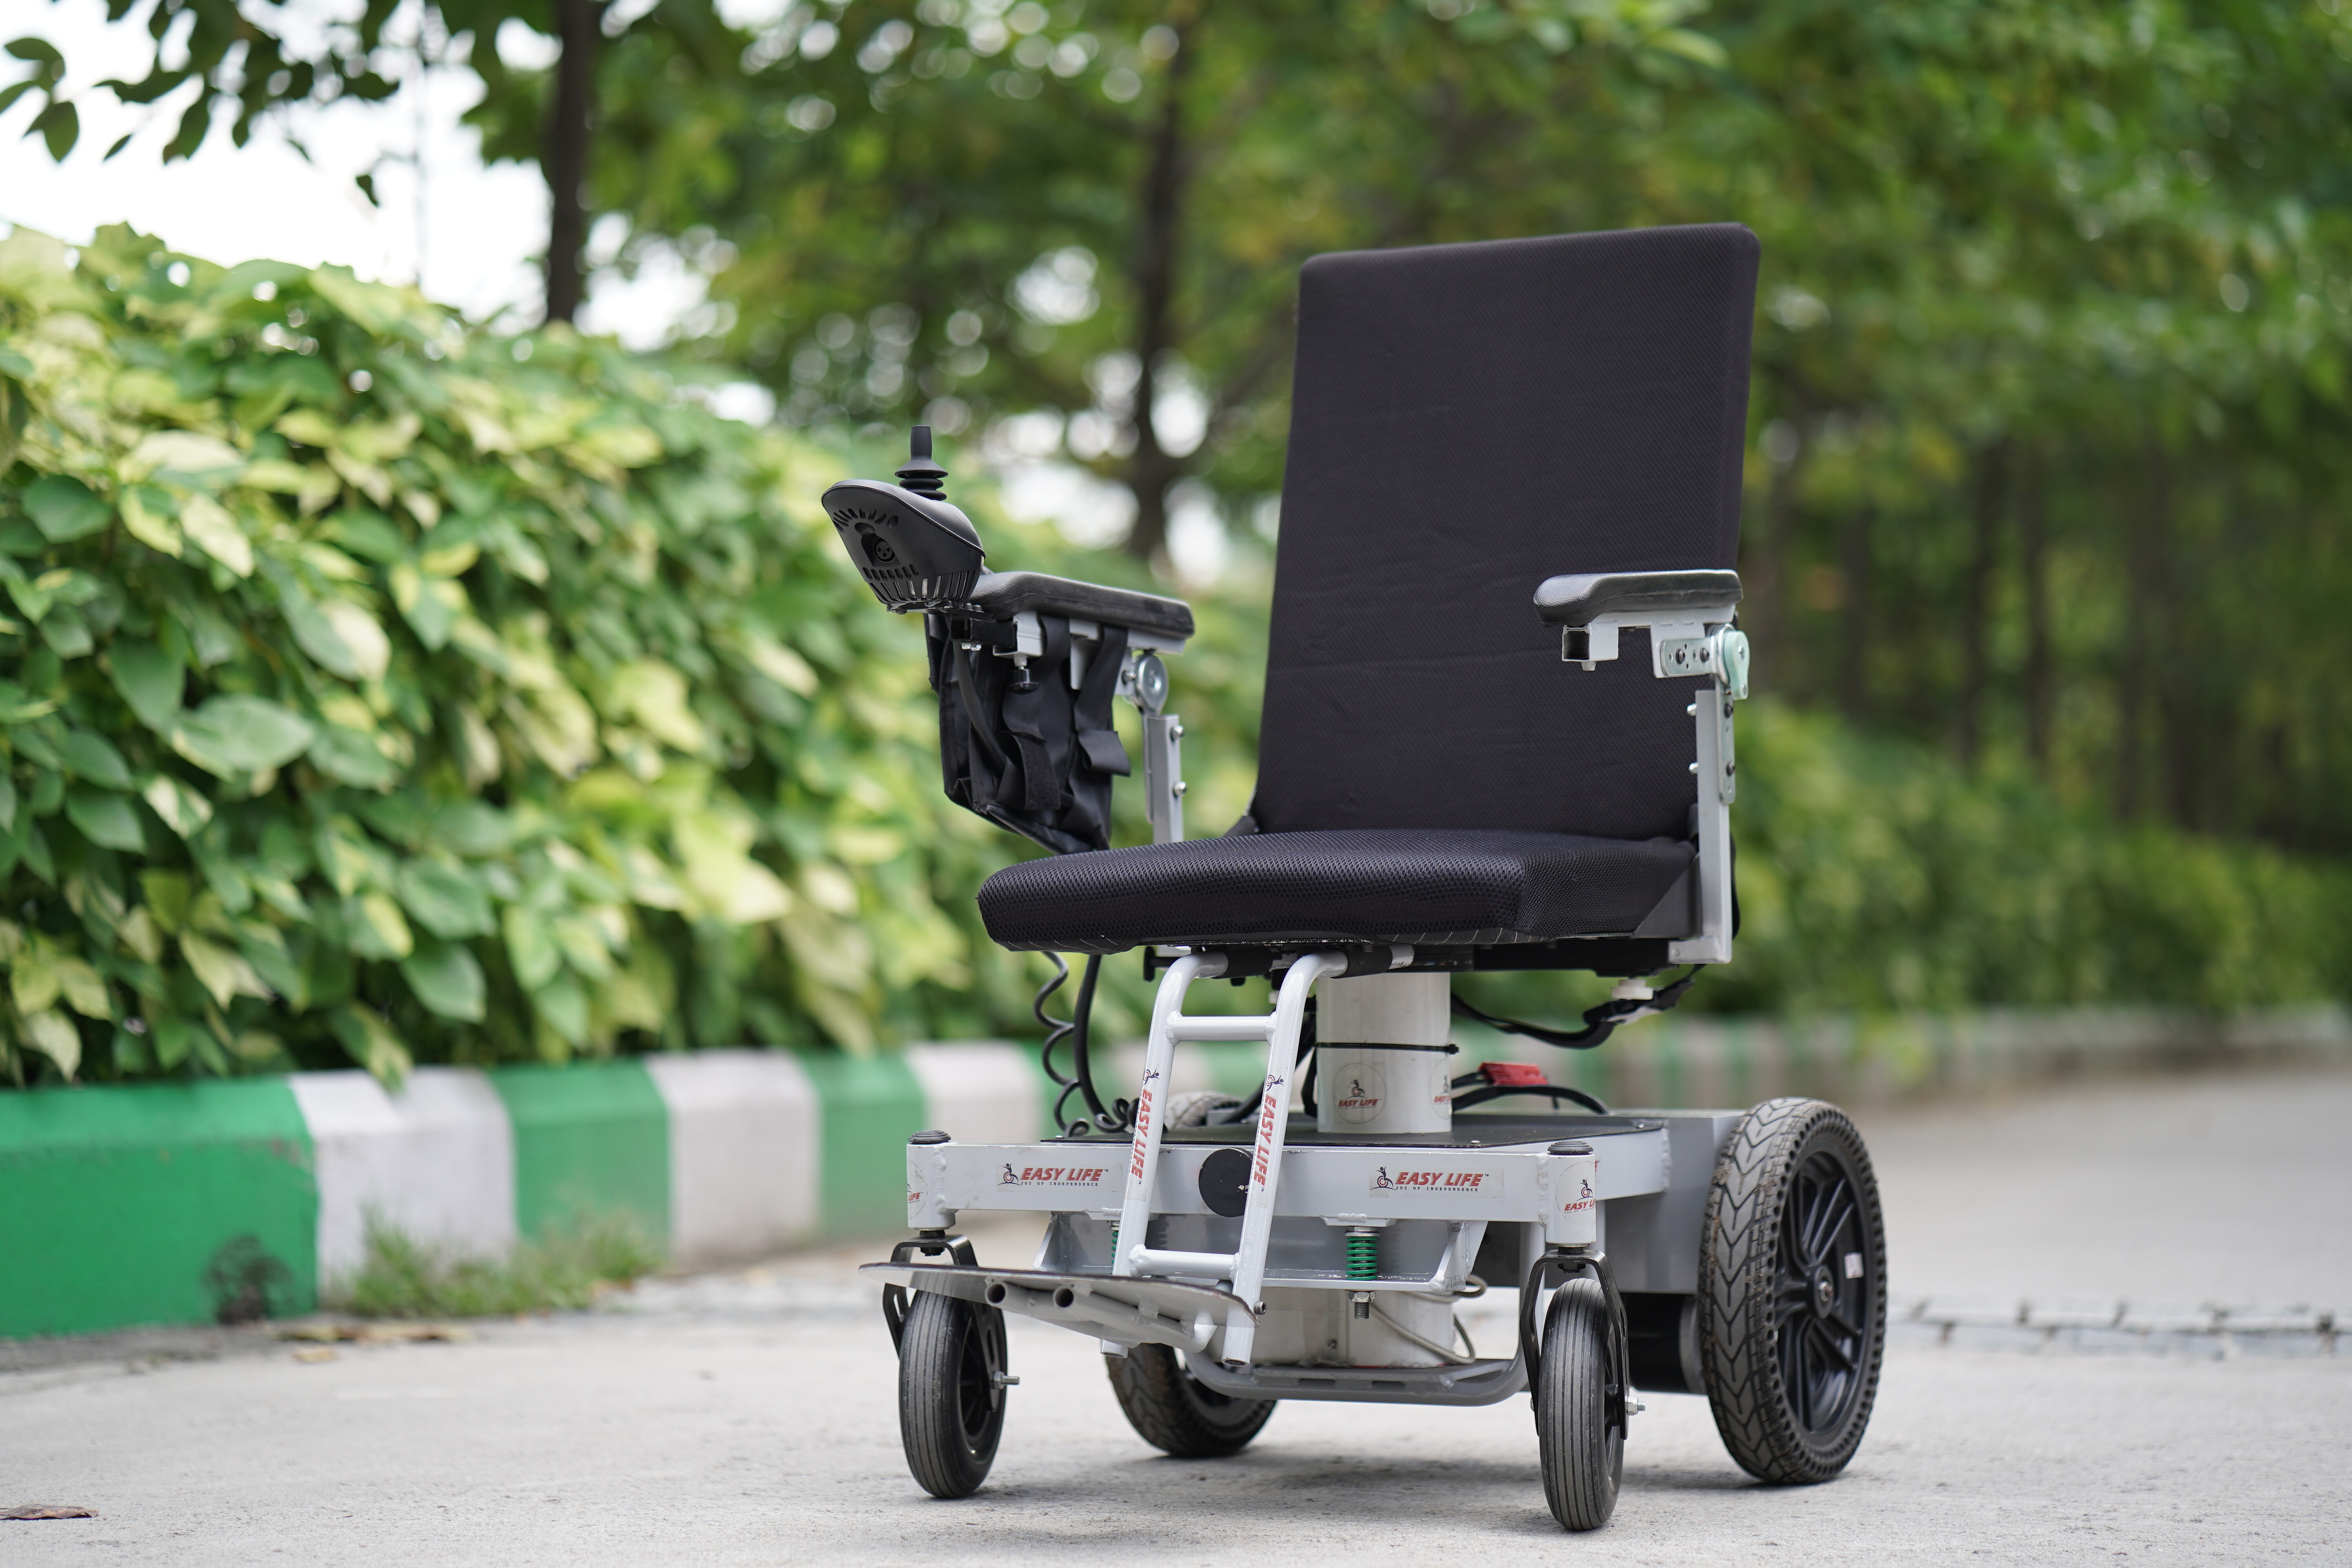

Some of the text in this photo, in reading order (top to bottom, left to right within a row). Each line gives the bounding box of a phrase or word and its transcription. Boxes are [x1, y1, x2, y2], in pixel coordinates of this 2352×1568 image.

[1138, 1089, 1152, 1138] EASY
[1260, 1093, 1276, 1145] EASY
[1131, 1139, 1146, 1179] LIFE
[1254, 1145, 1270, 1186] LIFE
[1019, 1168, 1066, 1181] EASY
[1065, 1169, 1103, 1181] LIFE
[1394, 1172, 1444, 1185] EASY
[1443, 1173, 1484, 1187] LIFE
[909, 1192, 920, 1201] LIFE
[1564, 1201, 1588, 1211] EASY
